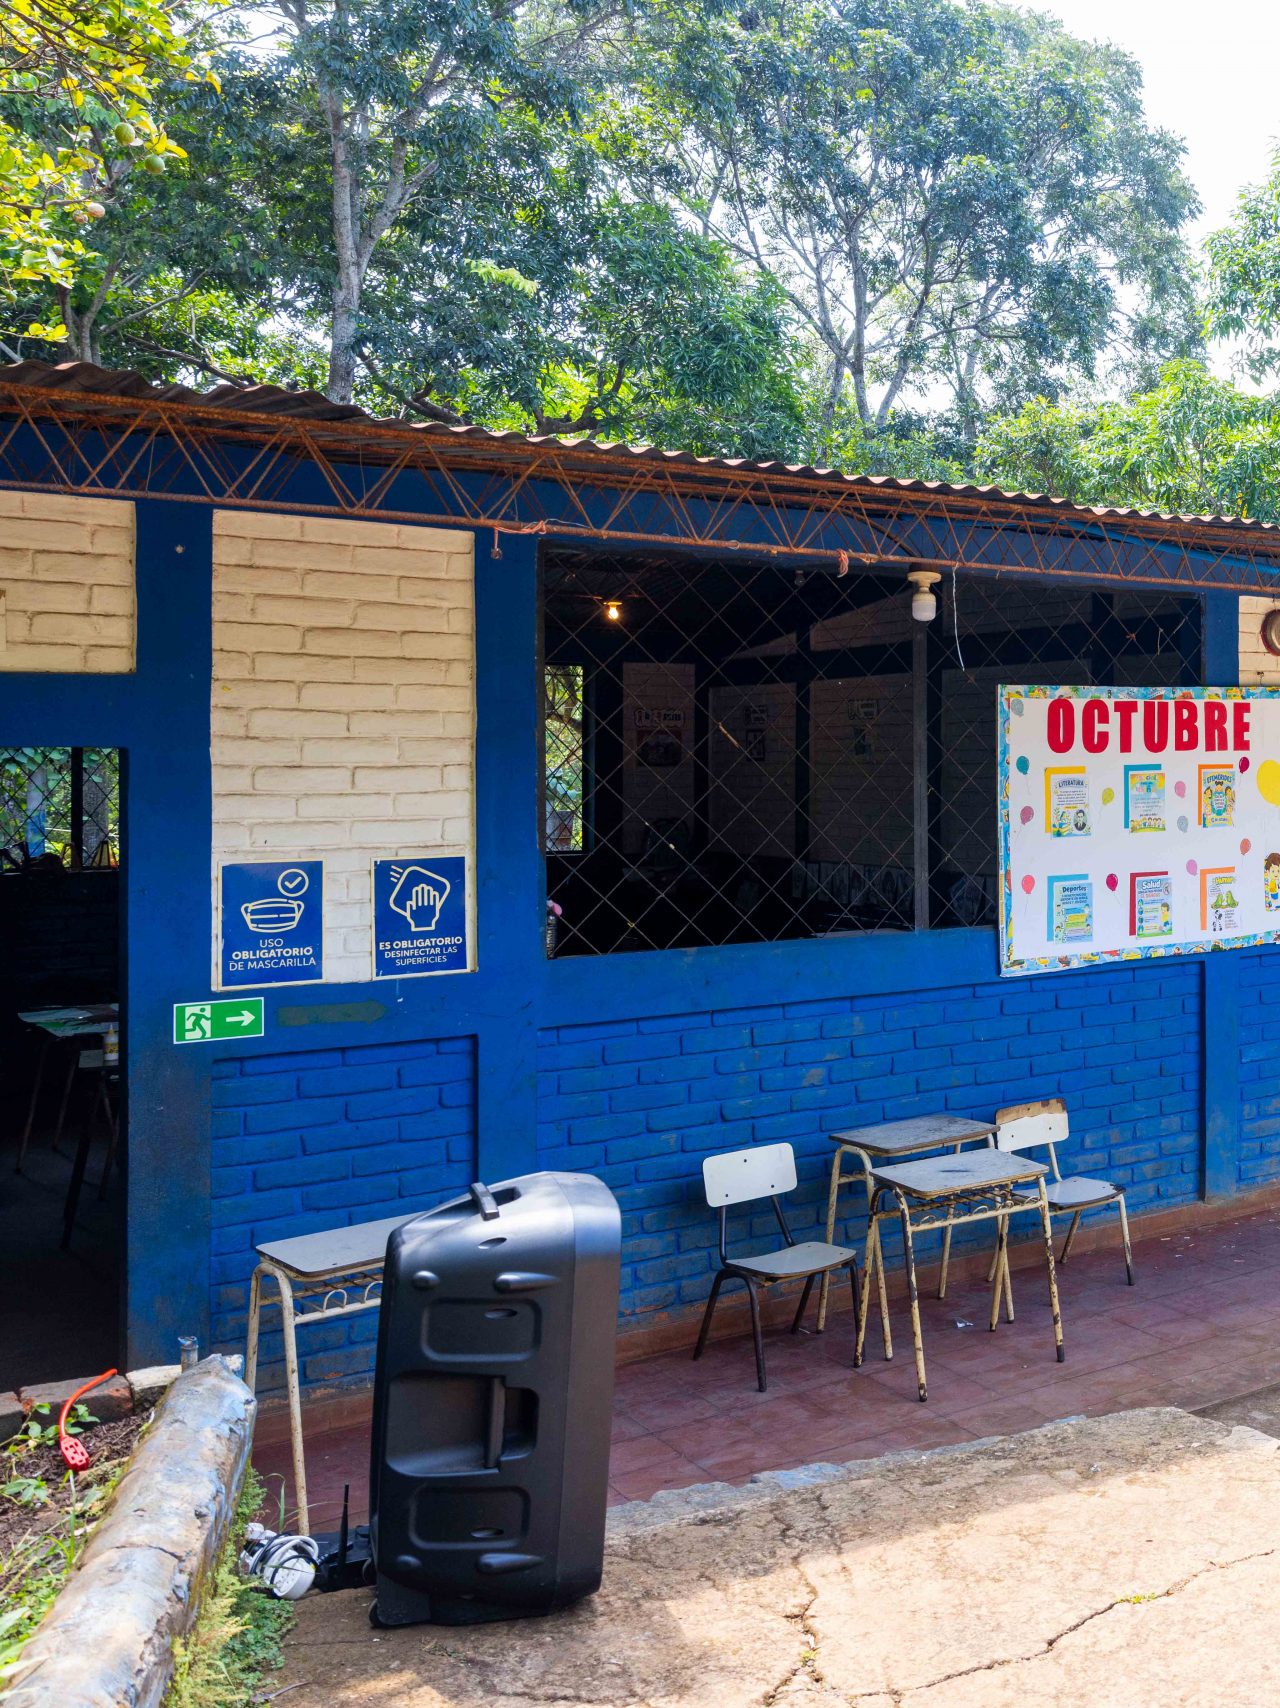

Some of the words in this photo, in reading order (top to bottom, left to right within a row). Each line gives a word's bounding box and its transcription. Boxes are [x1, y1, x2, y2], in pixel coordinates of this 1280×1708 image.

[1047, 698, 1250, 753] OCTUBRE
[1058, 779, 1085, 788] LITERATURA
[1062, 885, 1087, 893] Deportes
[1142, 879, 1161, 890] Salud
[259, 938, 284, 948] USO
[379, 942, 391, 950] ES
[393, 936, 462, 949] OBLIGATORIO
[231, 946, 313, 960] OBLIGATORIO
[385, 947, 441, 958] DESINFECTAR
[443, 945, 457, 954] LAS
[229, 961, 244, 971] DE
[247, 957, 316, 970] MASCARILLA
[395, 955, 447, 966] SUPERFICIES
